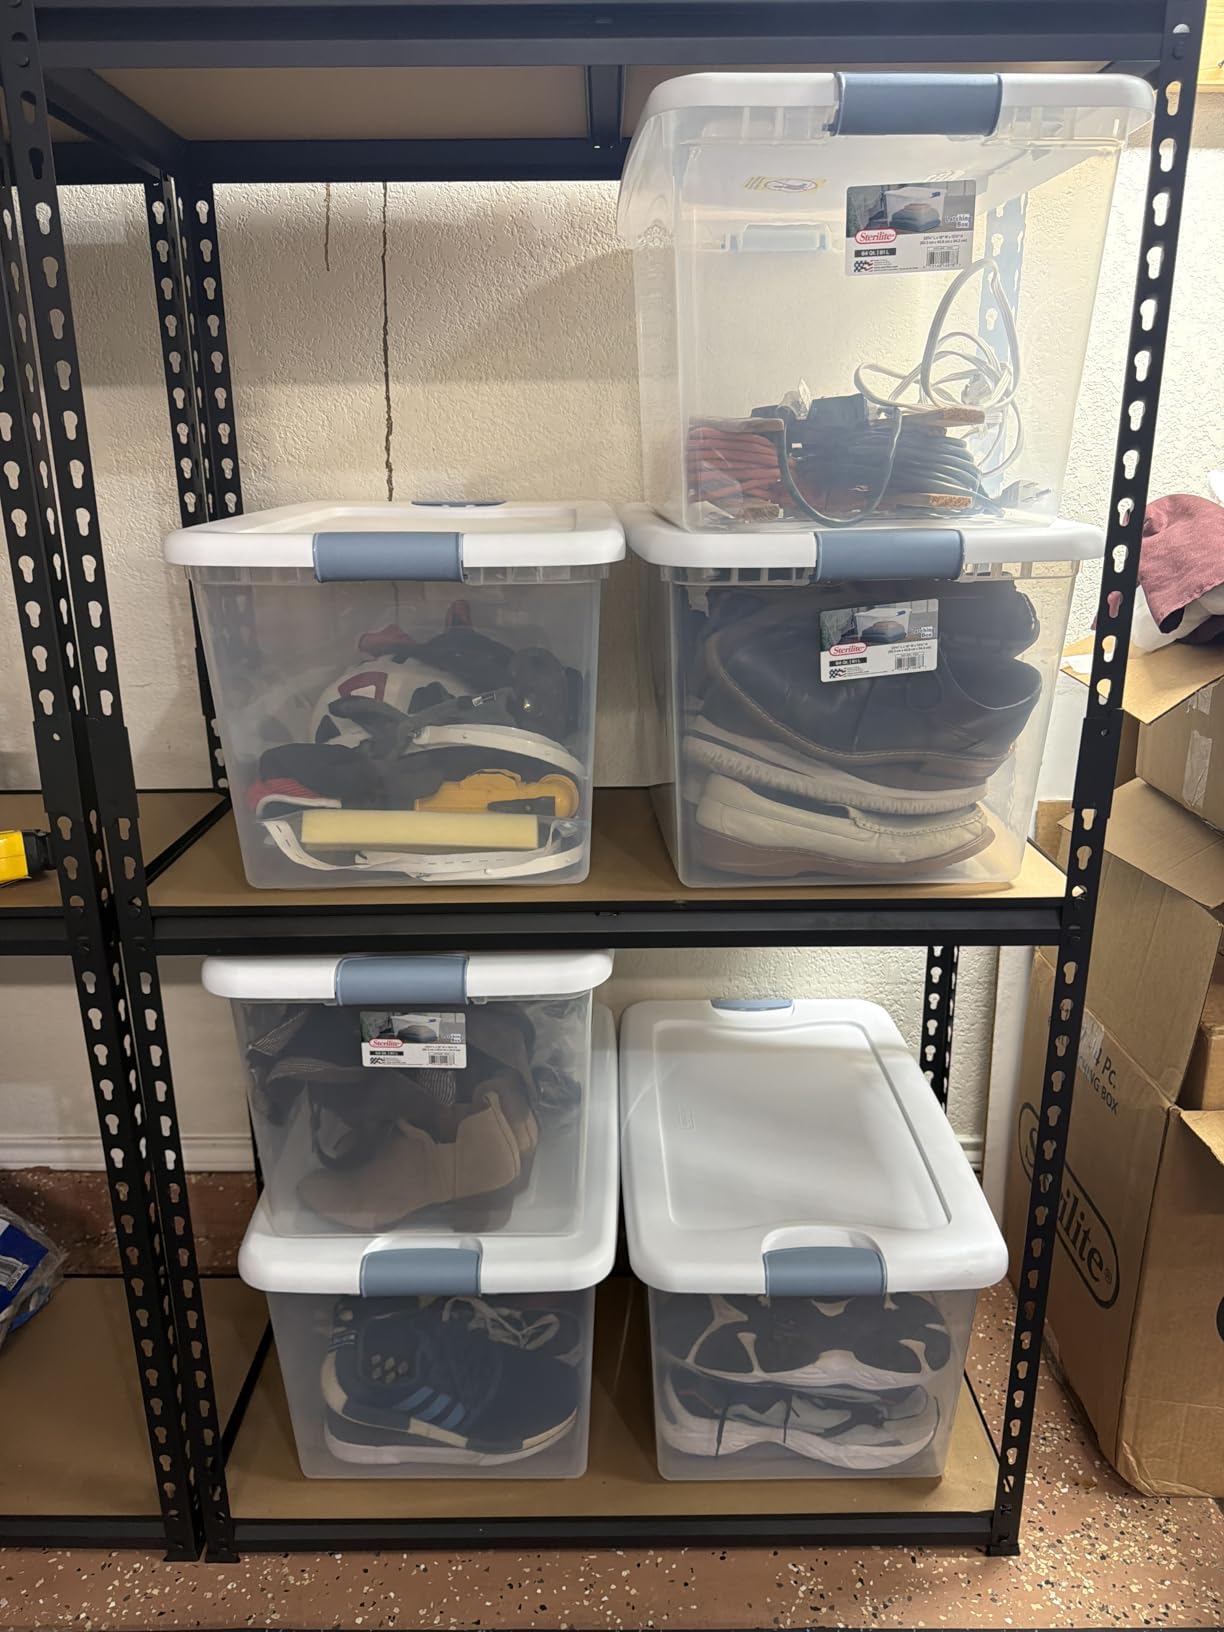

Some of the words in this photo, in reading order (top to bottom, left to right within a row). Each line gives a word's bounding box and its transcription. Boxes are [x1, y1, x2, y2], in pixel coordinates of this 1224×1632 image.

[860, 230, 890, 242] Sterilite
[833, 644, 860, 655] Sterilite
[1101, 1086, 1119, 1115] BOX
